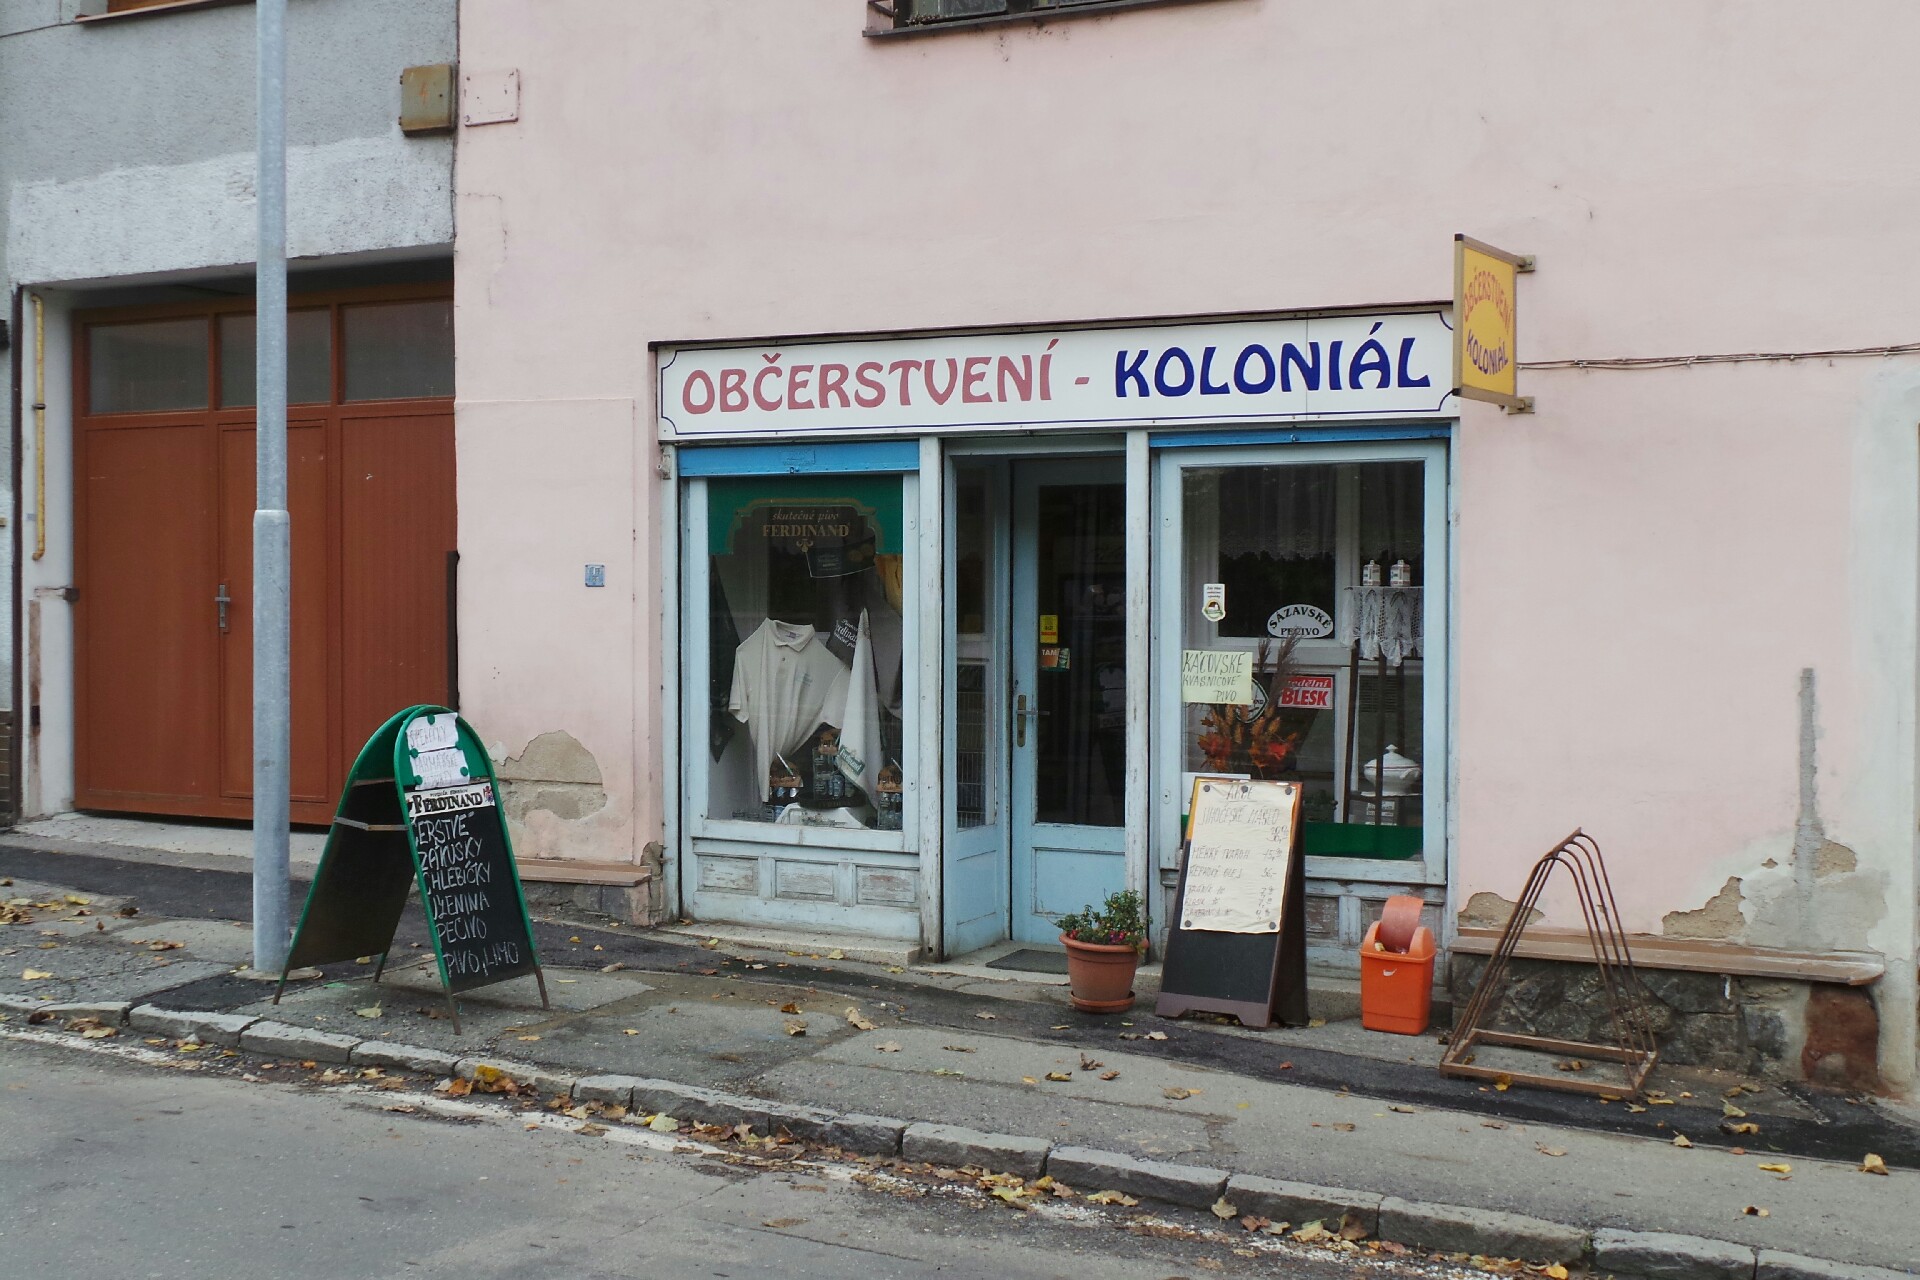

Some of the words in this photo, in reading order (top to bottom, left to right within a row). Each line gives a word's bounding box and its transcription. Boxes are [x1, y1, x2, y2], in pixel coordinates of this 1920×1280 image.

[1467, 329, 1509, 375] KOLONIÁL
[682, 338, 1060, 415] OBČERSTVENÍ
[1115, 322, 1431, 398] KOLONIÁL
[817, 509, 839, 522] pivo
[762, 524, 849, 537] FERDINAND
[1269, 606, 1332, 629] SÁZAVSKÉ
[1288, 679, 1329, 688] edělní
[1213, 690, 1237, 702] PIVO
[1282, 687, 1329, 706] BLESK
[412, 792, 483, 814] FERDINAND
